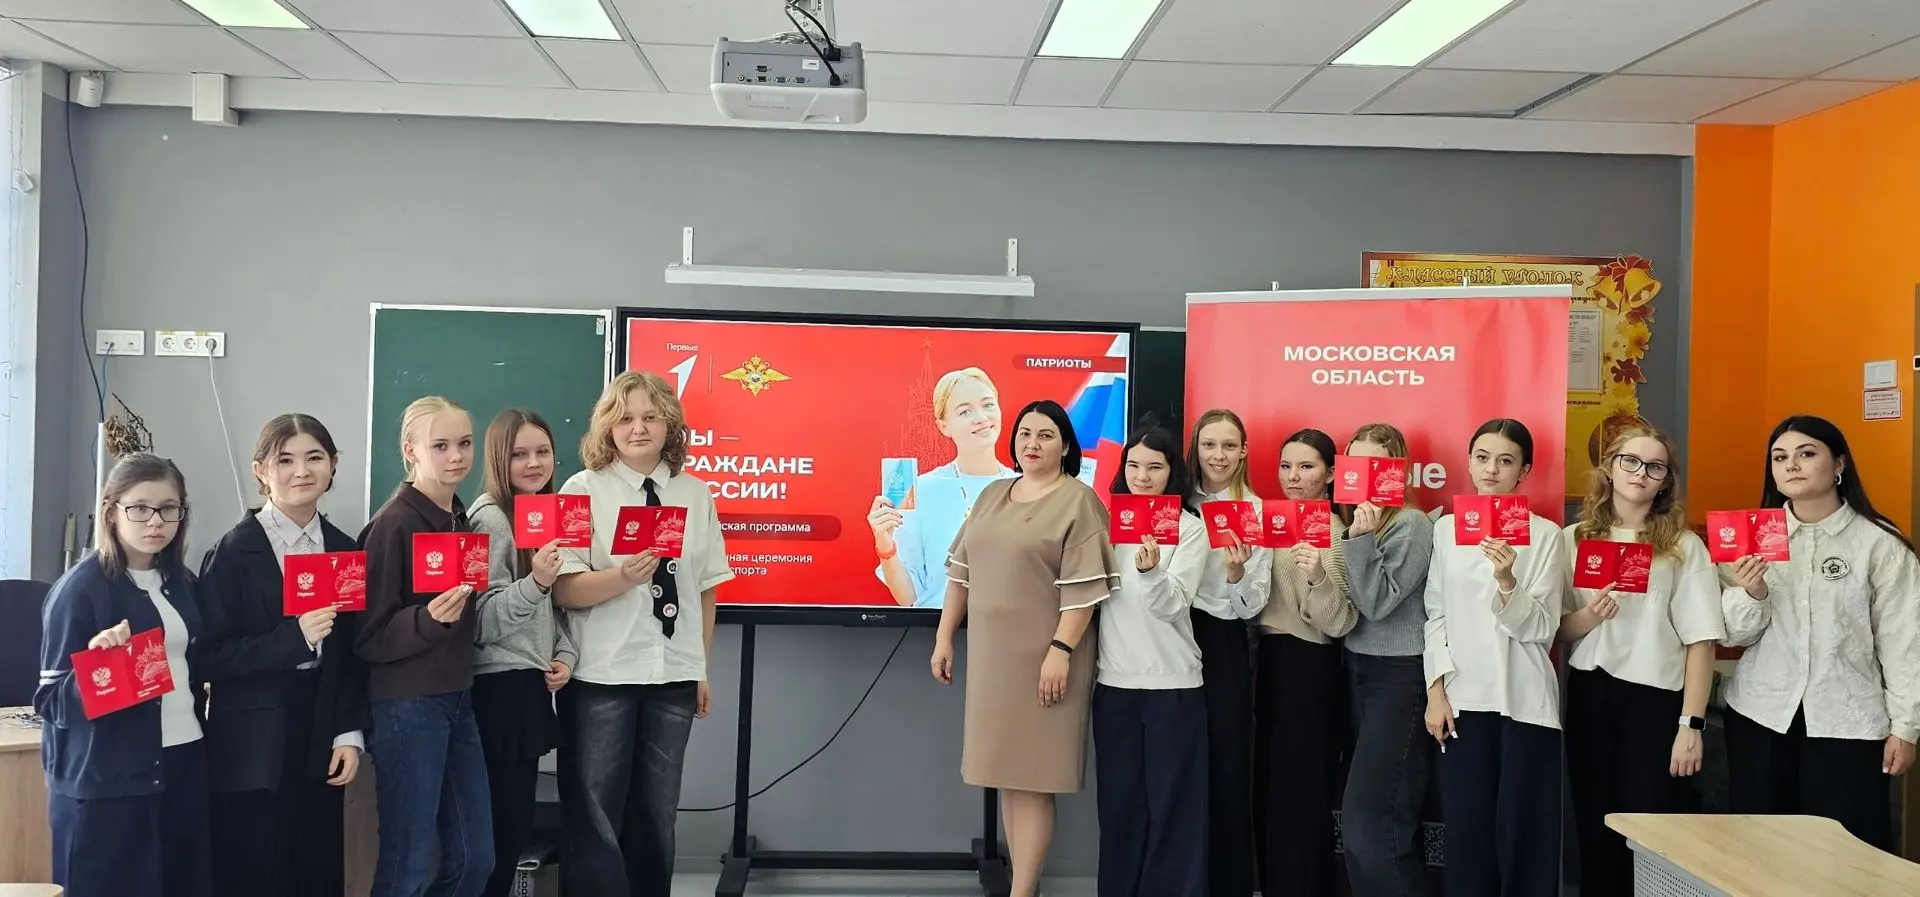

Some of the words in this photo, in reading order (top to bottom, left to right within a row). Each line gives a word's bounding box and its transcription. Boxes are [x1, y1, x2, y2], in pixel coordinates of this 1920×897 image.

[666, 342, 700, 353] Первые
[1283, 345, 1456, 362] МОСКОВСКАЯ
[1026, 357, 1092, 369] ПАТРИОТЫ
[1311, 369, 1425, 386] ОБЛАСТЬ
[688, 428, 714, 447] Ы
[681, 454, 815, 477] РАЖДАНЕ
[704, 480, 787, 500] ССИИ!
[749, 523, 812, 533] программа
[751, 554, 813, 565] церемония
